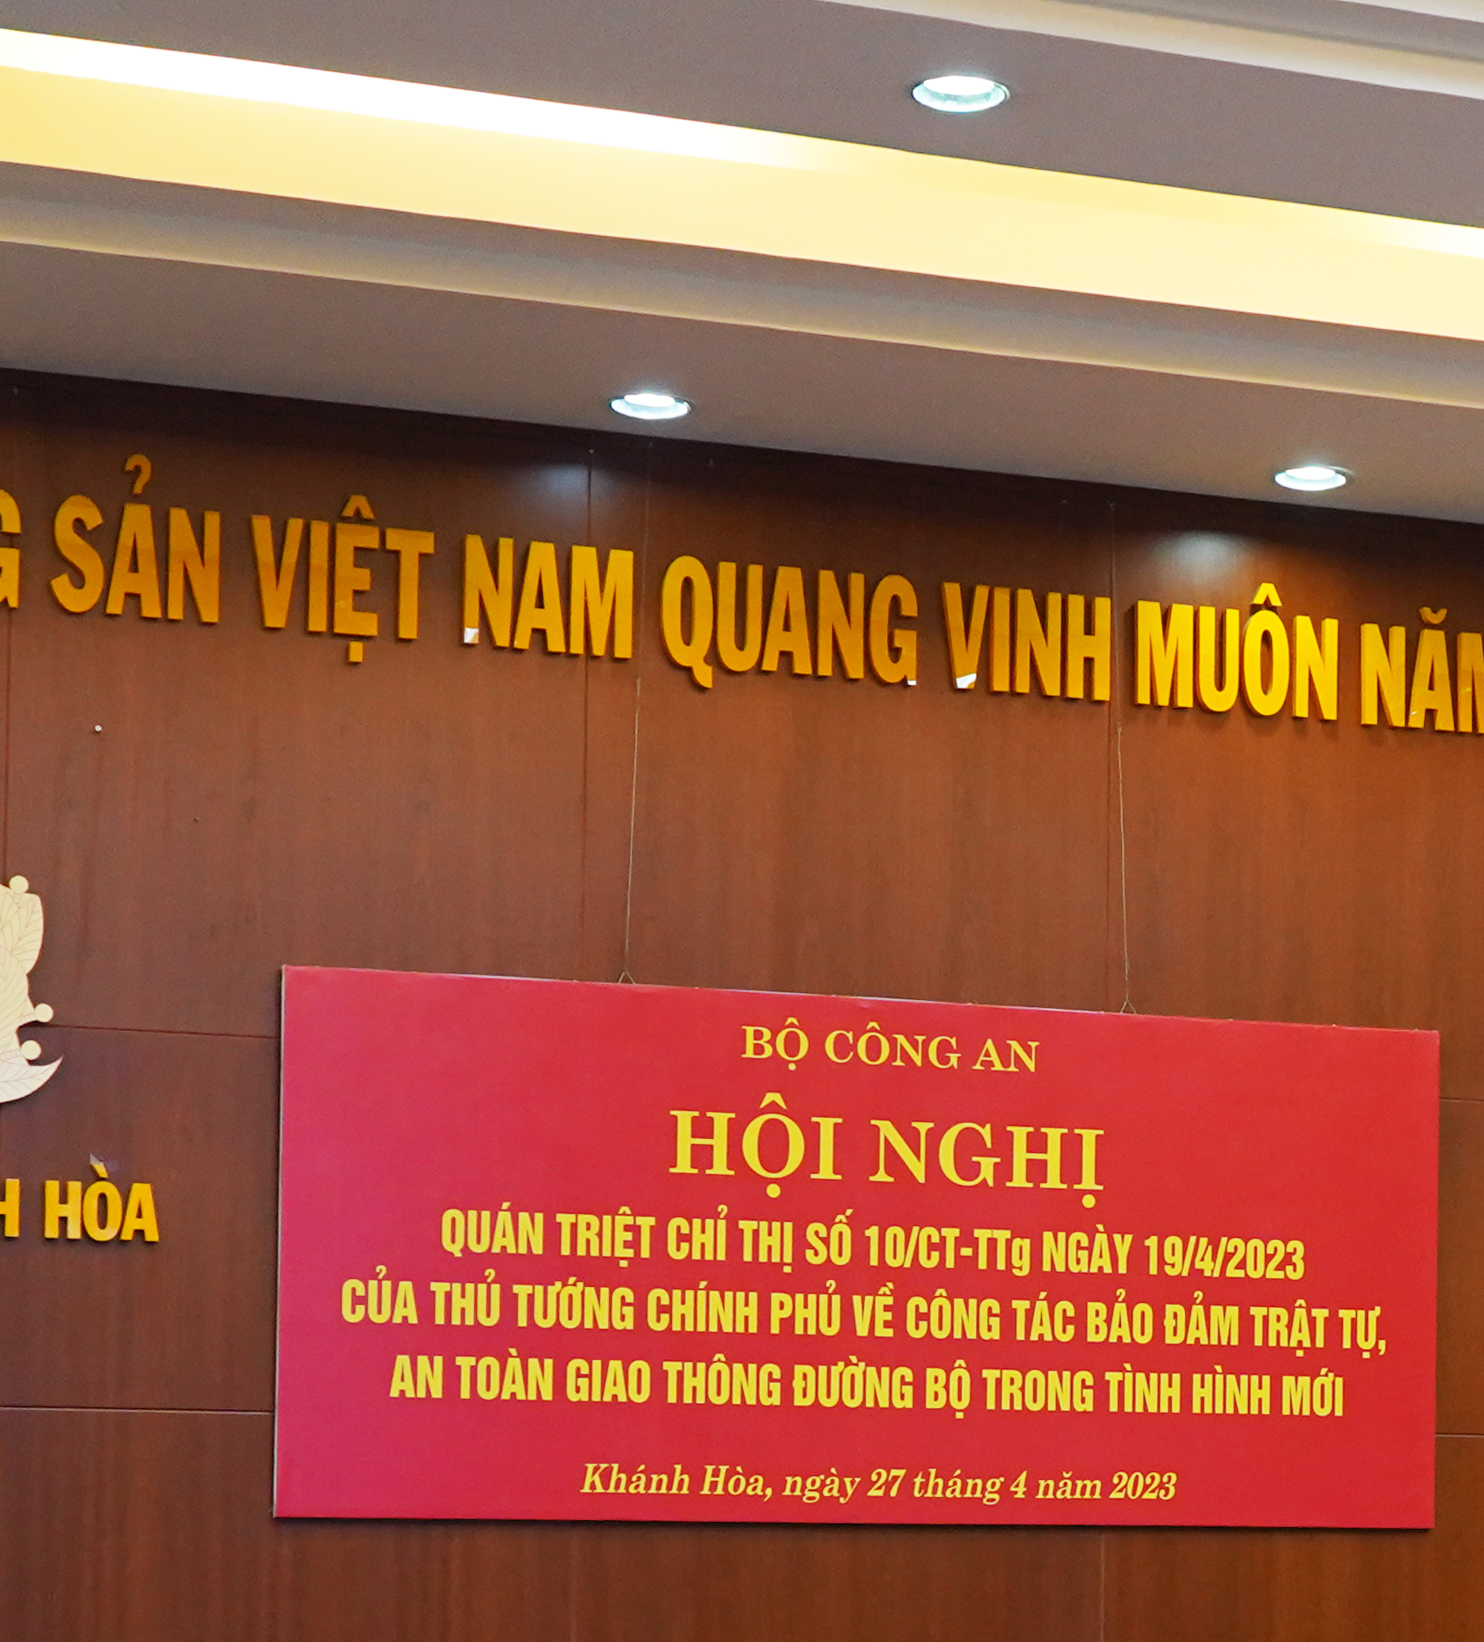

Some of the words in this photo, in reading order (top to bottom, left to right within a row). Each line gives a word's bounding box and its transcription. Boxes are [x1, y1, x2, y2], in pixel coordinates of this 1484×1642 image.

[51, 455, 220, 622] SẢN
[252, 495, 434, 662] VIỆT
[464, 535, 634, 658] NAM
[661, 556, 918, 688] QUANG
[943, 582, 1111, 701] VINH
[1136, 577, 1339, 720] MUÔN
[741, 1016, 809, 1071] BỘ
[824, 1021, 962, 1069] CÔNG
[971, 1038, 1040, 1073] AN
[668, 1092, 843, 1199] HỘI
[868, 1119, 1105, 1209] NGHỊ
[44, 1154, 159, 1242] HÒA
[441, 1201, 544, 1258] QUÁN
[555, 1205, 656, 1268] TRIỆT
[667, 1204, 728, 1261] CHỈ
[738, 1219, 793, 1273] THỊ
[805, 1208, 854, 1266] SỐ
[864, 1225, 1031, 1277] 10/CT-TTg
[1042, 1223, 1134, 1274] NGÀY
[1144, 1235, 1305, 1281] 19/4/2023
[341, 1264, 419, 1324] CỦA
[429, 1268, 501, 1327] THỦ
[512, 1276, 635, 1331] TƯỚNG
[647, 1280, 758, 1334] CHÍNH
[770, 1279, 841, 1337] PHỦ
[852, 1281, 894, 1338] VỀ
[906, 1288, 1001, 1341] CÔNG
[1011, 1291, 1075, 1343] TÁC
[1086, 1288, 1154, 1345] BẢO
[1163, 1290, 1239, 1346] ĐẢM
[1249, 1298, 1330, 1357] TRẬT
[1338, 1305, 1386, 1359] TỰ,
[389, 1354, 444, 1399] AN
[455, 1347, 554, 1401] TOÀN
[566, 1358, 651, 1404] GIAO
[662, 1353, 782, 1406] THÔNG
[792, 1355, 914, 1409] ĐƯỜNG
[925, 1359, 971, 1419] BỘ
[981, 1368, 1094, 1412] TRONG
[1104, 1362, 1181, 1414] TÌNH
[1192, 1364, 1271, 1415] HÌNH
[1281, 1367, 1344, 1417] MỚI
[579, 1463, 690, 1495] Khánh
[699, 1465, 773, 1502] Hòa,
[781, 1467, 862, 1504] ngày
[866, 1468, 907, 1497] 27
[913, 1468, 1005, 1505] tháng
[1009, 1470, 1028, 1499] 4
[1035, 1471, 1102, 1500] năm
[1108, 1471, 1177, 1501] 2023
